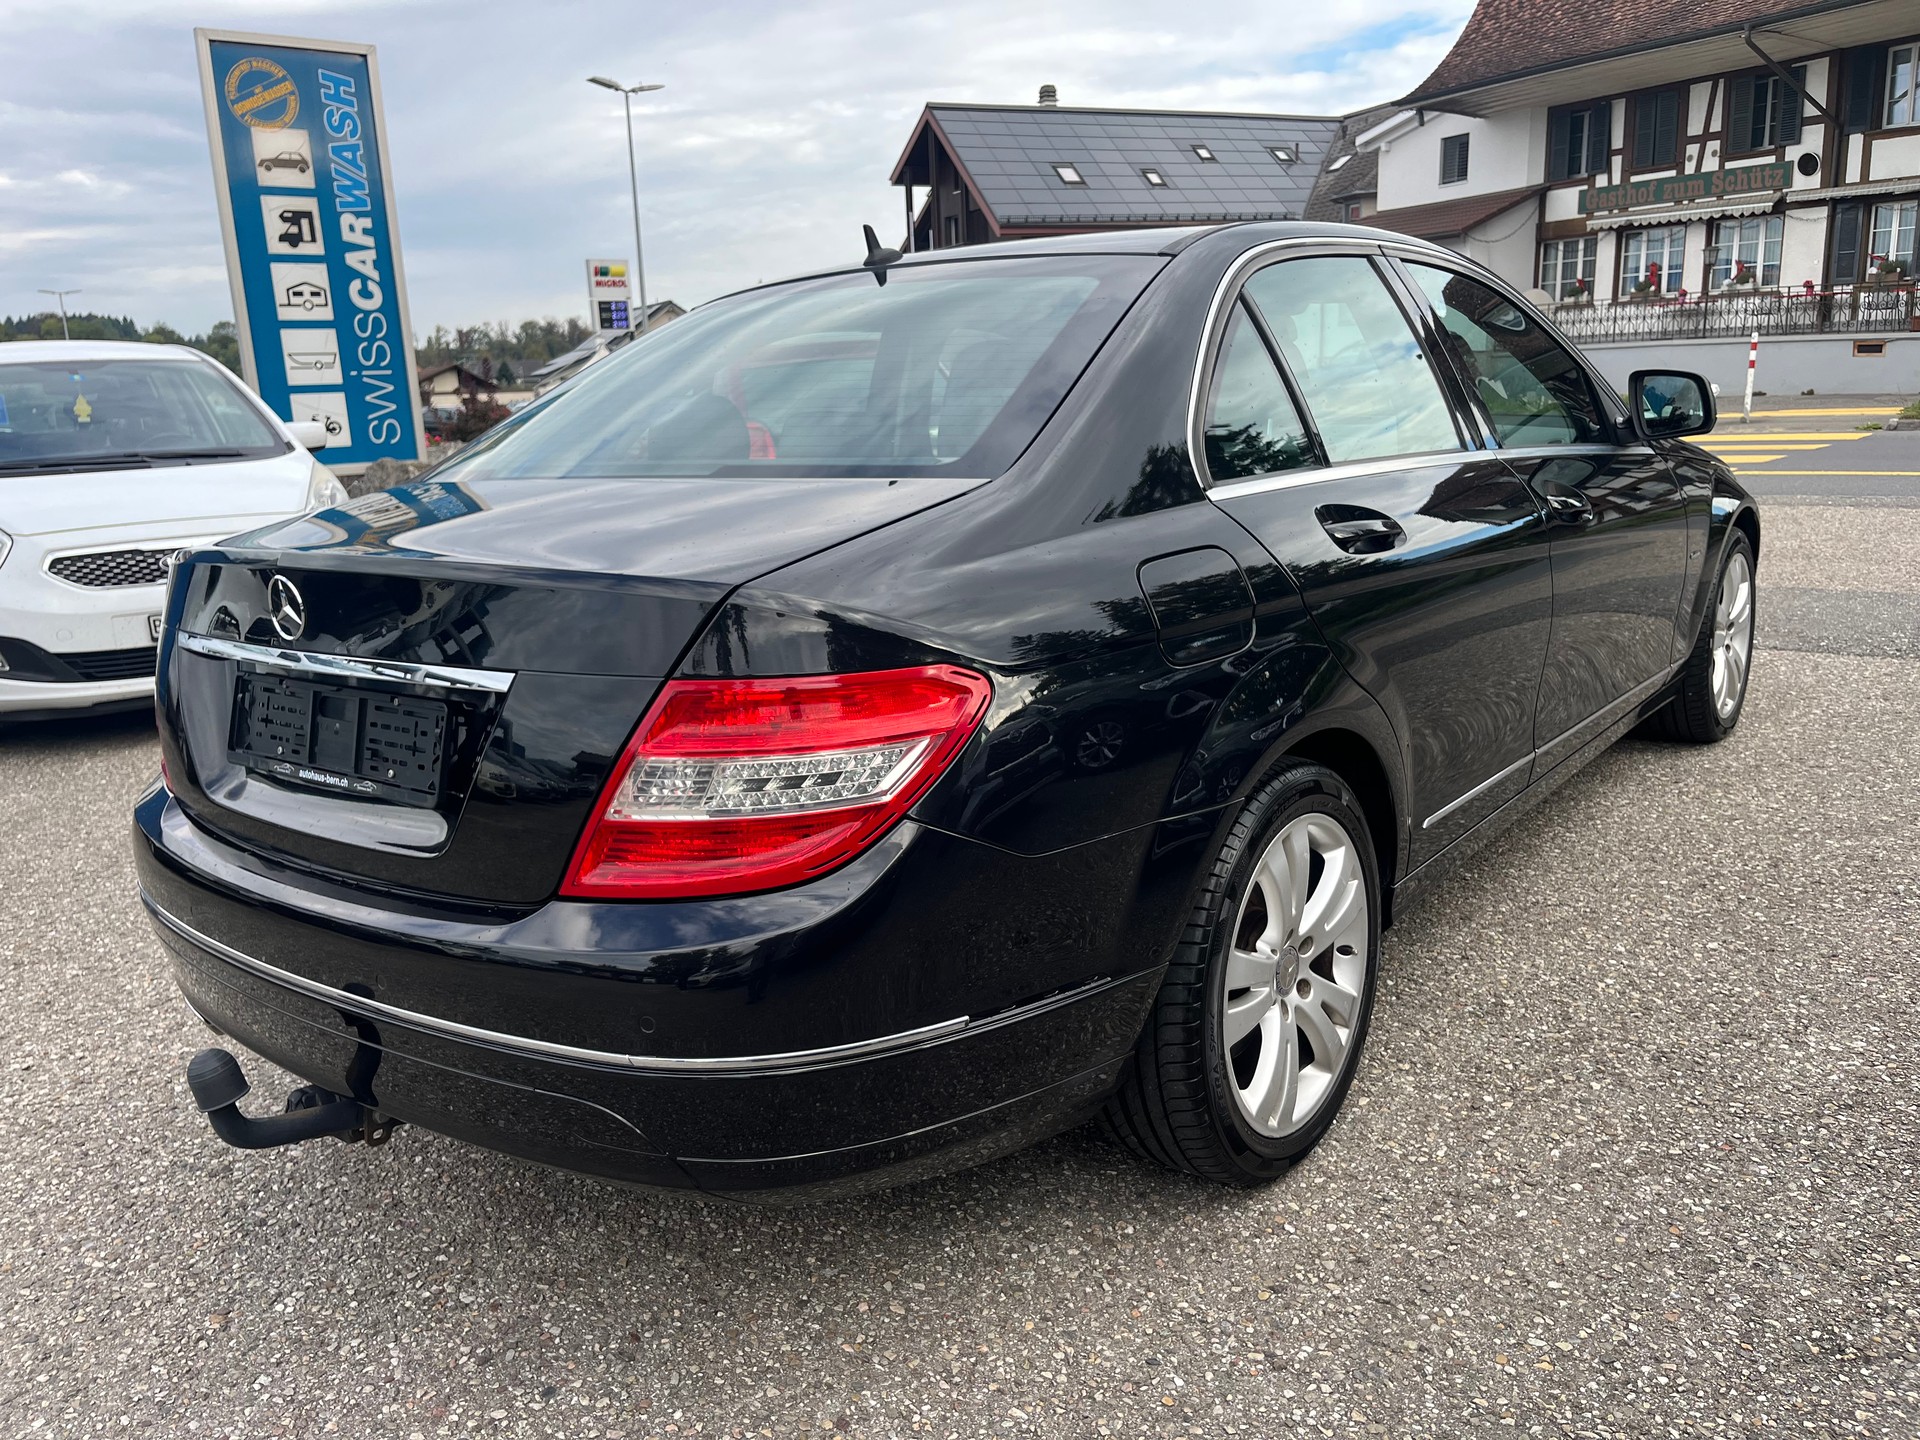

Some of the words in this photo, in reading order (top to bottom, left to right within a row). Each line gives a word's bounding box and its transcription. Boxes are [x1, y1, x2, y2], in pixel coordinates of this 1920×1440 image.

[1586, 181, 1656, 210] Gasthof
[1663, 179, 1705, 200] zum
[1711, 167, 1785, 194] Schütz
[595, 279, 628, 288] MIGROL
[299, 769, 349, 788] autohaus-bern.ch
